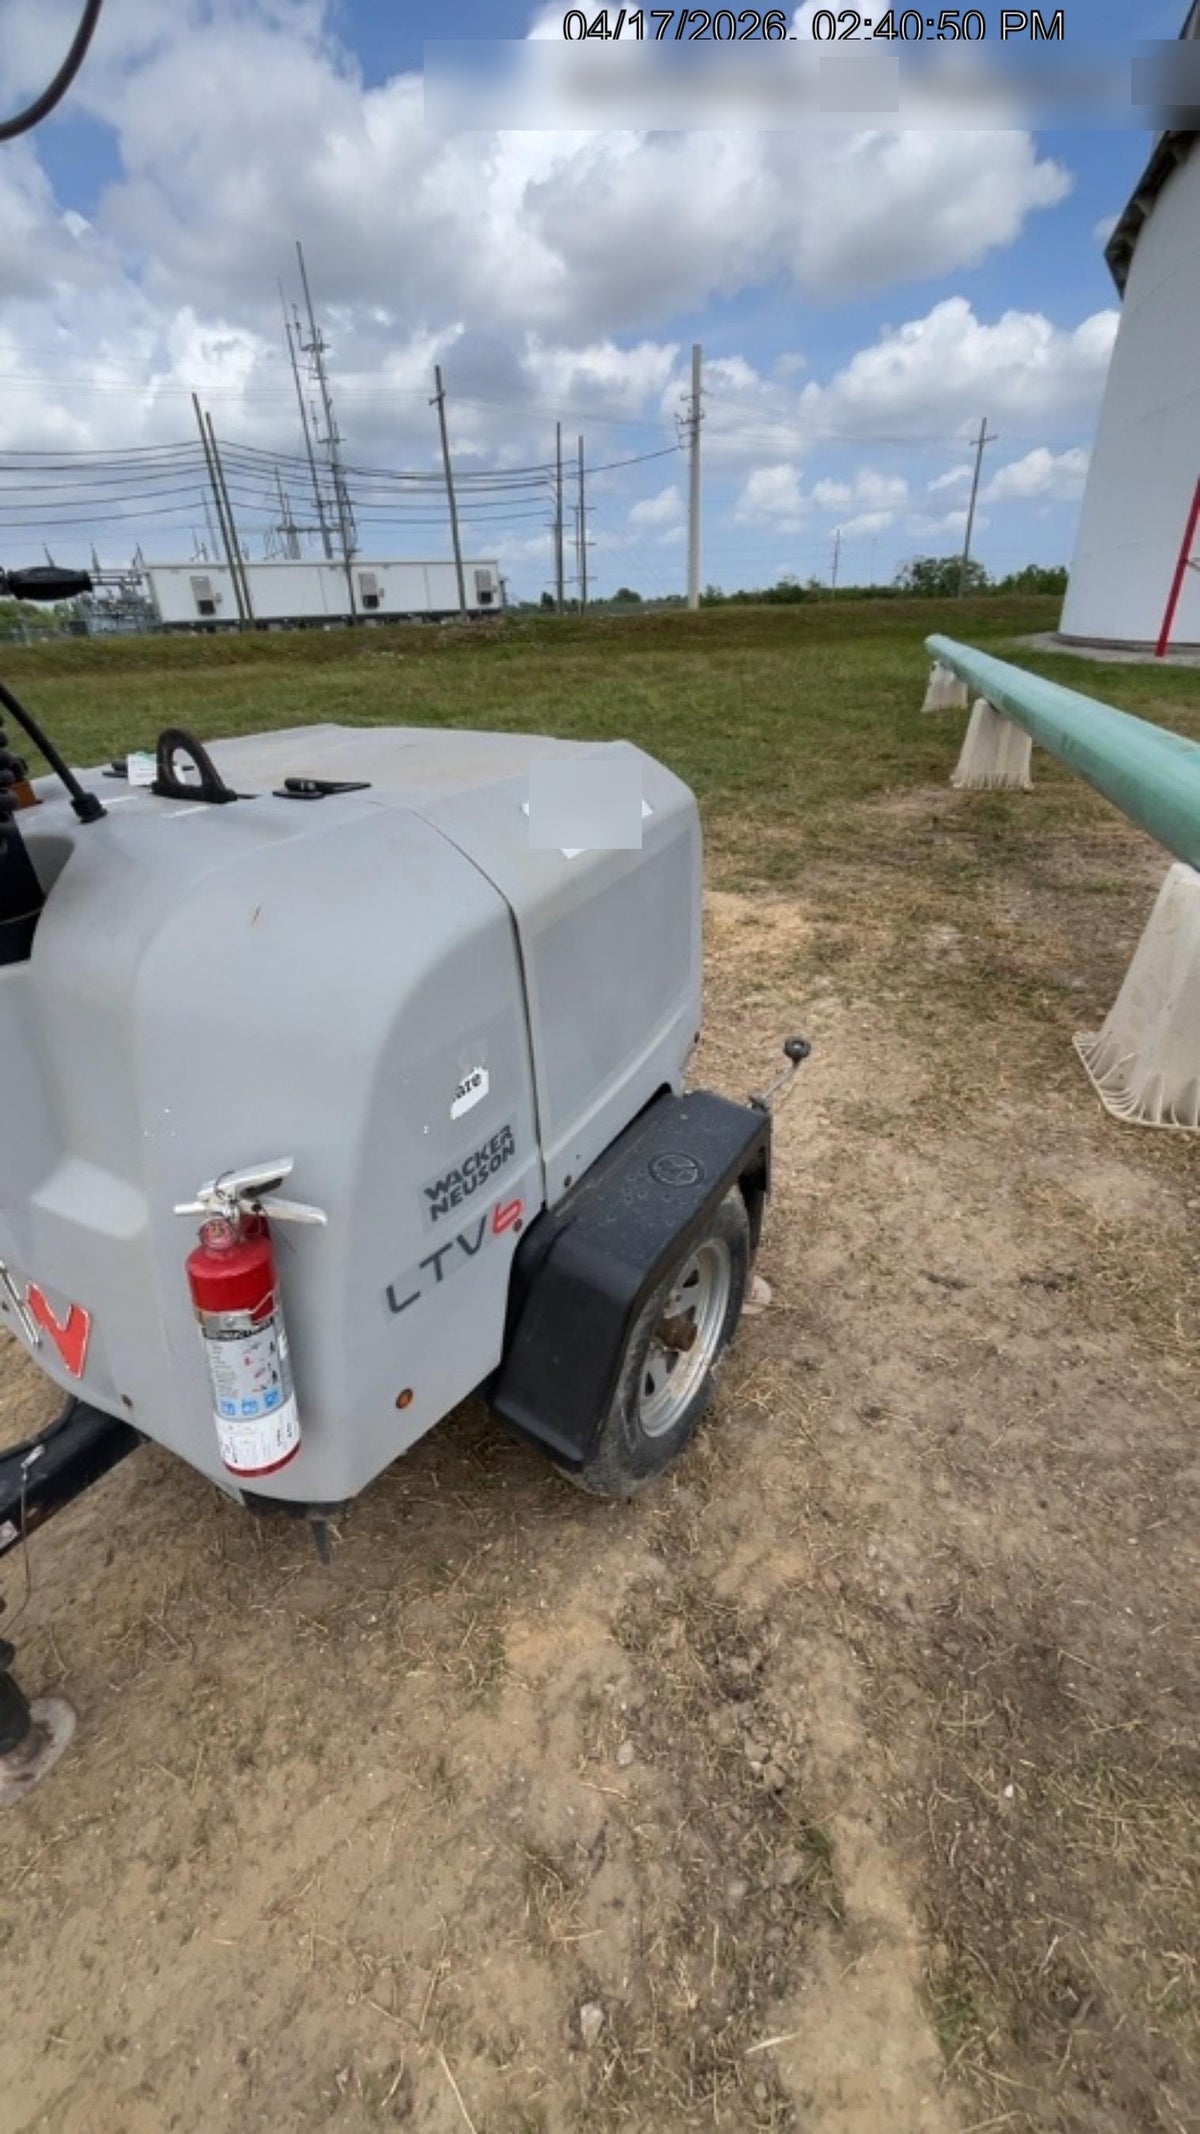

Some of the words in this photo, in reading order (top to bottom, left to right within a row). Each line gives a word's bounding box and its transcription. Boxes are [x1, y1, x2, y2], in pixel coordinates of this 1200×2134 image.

[452, 1073, 481, 1102] are
[424, 1124, 512, 1201] WACKER
[430, 1139, 515, 1222] NEUSON
